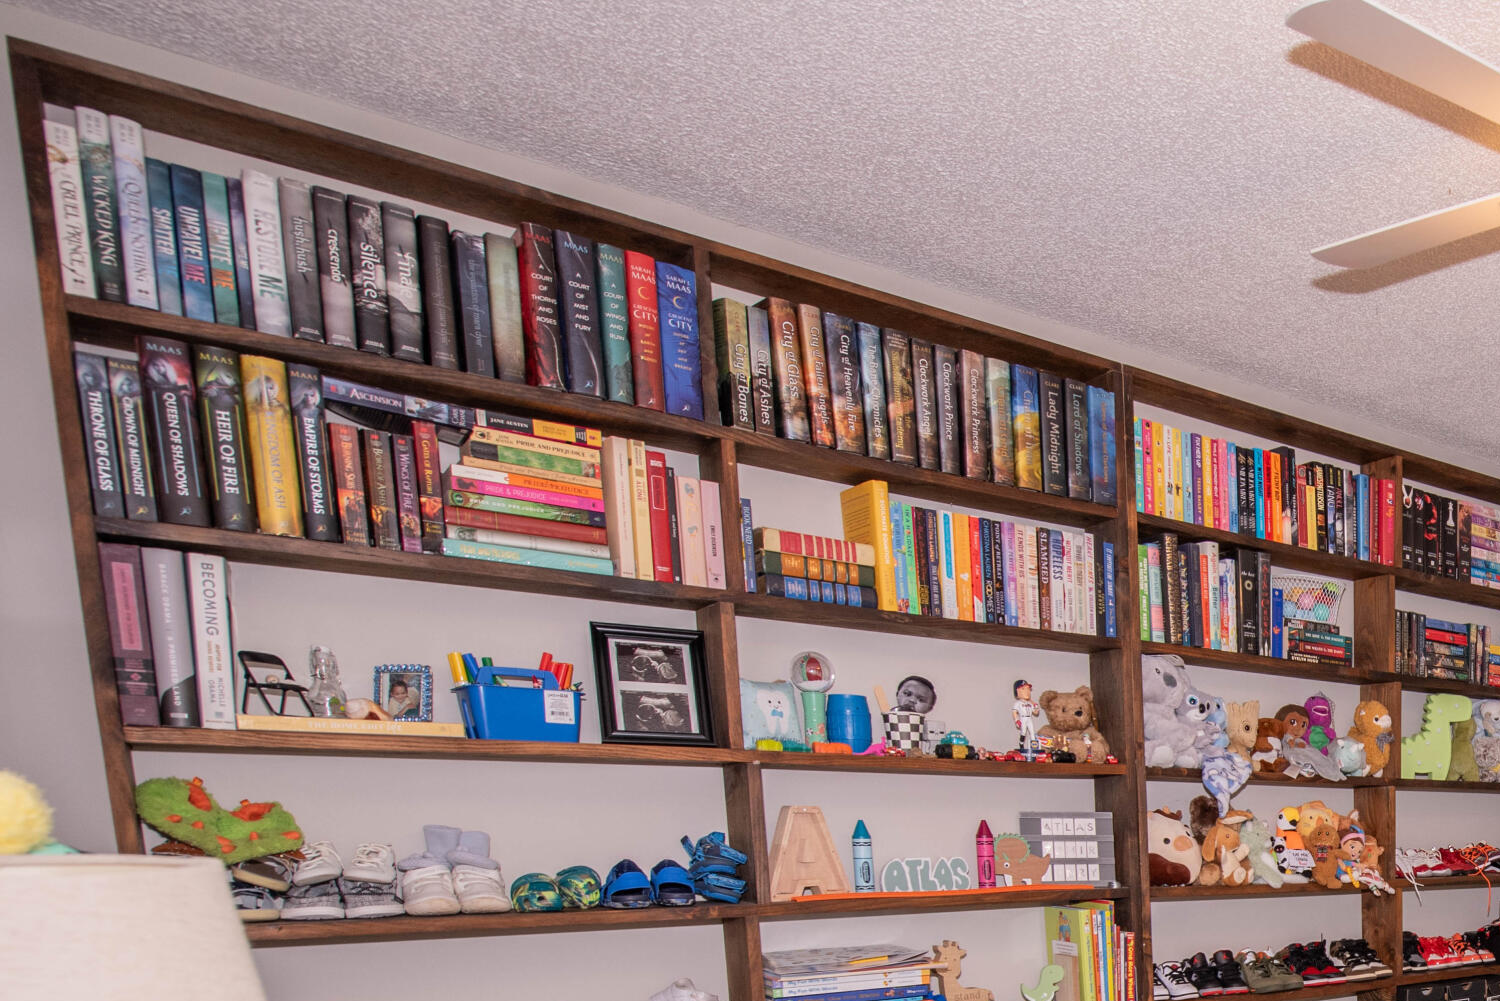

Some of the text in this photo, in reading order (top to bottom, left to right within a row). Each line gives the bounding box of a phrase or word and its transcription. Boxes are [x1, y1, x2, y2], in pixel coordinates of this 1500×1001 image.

[92, 175, 117, 267] WICKED KING
[152, 207, 175, 256] SHATTER
[177, 206, 206, 284] UNRAVEL ME
[208, 220, 235, 291] IGNITE ME
[253, 208, 287, 302] RESTORE ME
[327, 228, 347, 283] crescendo
[564, 241, 588, 254] MAAS
[600, 253, 623, 264] MAAS
[359, 242, 381, 299] silence
[397, 250, 416, 299] finale
[531, 272, 553, 283] COURT
[568, 280, 590, 290] COURT
[631, 271, 656, 285] MAAS
[666, 275, 686, 285] SARAH
[666, 280, 692, 294] MAAS
[531, 294, 557, 305] THORNS
[538, 306, 553, 314] AND
[574, 303, 588, 311] MIST
[603, 291, 624, 301] COURT
[536, 315, 557, 325] ROSES
[575, 313, 590, 321] AND
[575, 323, 591, 332] FURY
[605, 312, 626, 322] WINGS
[610, 323, 624, 331] AND
[633, 310, 658, 323] CITY
[668, 318, 693, 331] CITY
[146, 343, 182, 355] MAAS
[200, 352, 233, 365] MAAS
[780, 321, 800, 398] City Glass
[290, 370, 318, 381] MAAS
[734, 344, 749, 423] City Bones
[756, 350, 773, 425] City Ashes
[809, 326, 832, 425] City Fallen Angels
[840, 335, 857, 431] City Heavenly Fire
[350, 388, 403, 408] ASCENSION
[871, 383, 883, 438] Chronicles
[918, 358, 933, 440] Clockwork Angel
[942, 362, 953, 441] Clockwork Prince
[970, 368, 980, 454] Clockwork Princess
[88, 391, 113, 491] THRONE OF GLASS
[490, 416, 529, 428] JANE AUSTEN
[1047, 391, 1060, 474] Lady Midnight
[1072, 393, 1083, 476] Lord Shadows
[122, 396, 146, 496] CROWN OF MIDNIGHT
[163, 392, 190, 496] QUEEN OF SHADOWS
[215, 410, 240, 495] HEIR OF FIRE
[264, 410, 287, 510] KINGDOM OF ASH
[421, 440, 430, 459] GATES
[515, 439, 536, 448] PRIDE
[537, 442, 551, 451] AND
[304, 417, 325, 515] EMPIRE OF STORMS
[399, 451, 412, 514] WINGS FIRE
[743, 506, 752, 545] BOOK NERD
[1040, 531, 1049, 584] SLAMMED
[1052, 538, 1063, 580] HOPELESS
[200, 562, 219, 636] BECOMING
[158, 563, 169, 595] BARACK
[172, 685, 182, 707] LAND
[208, 679, 216, 704] OBAMA
[215, 677, 226, 708] MICHELLE
[1043, 821, 1094, 832] ATLAS
[881, 857, 971, 893] ATLAS
[954, 990, 981, 1001] stand
